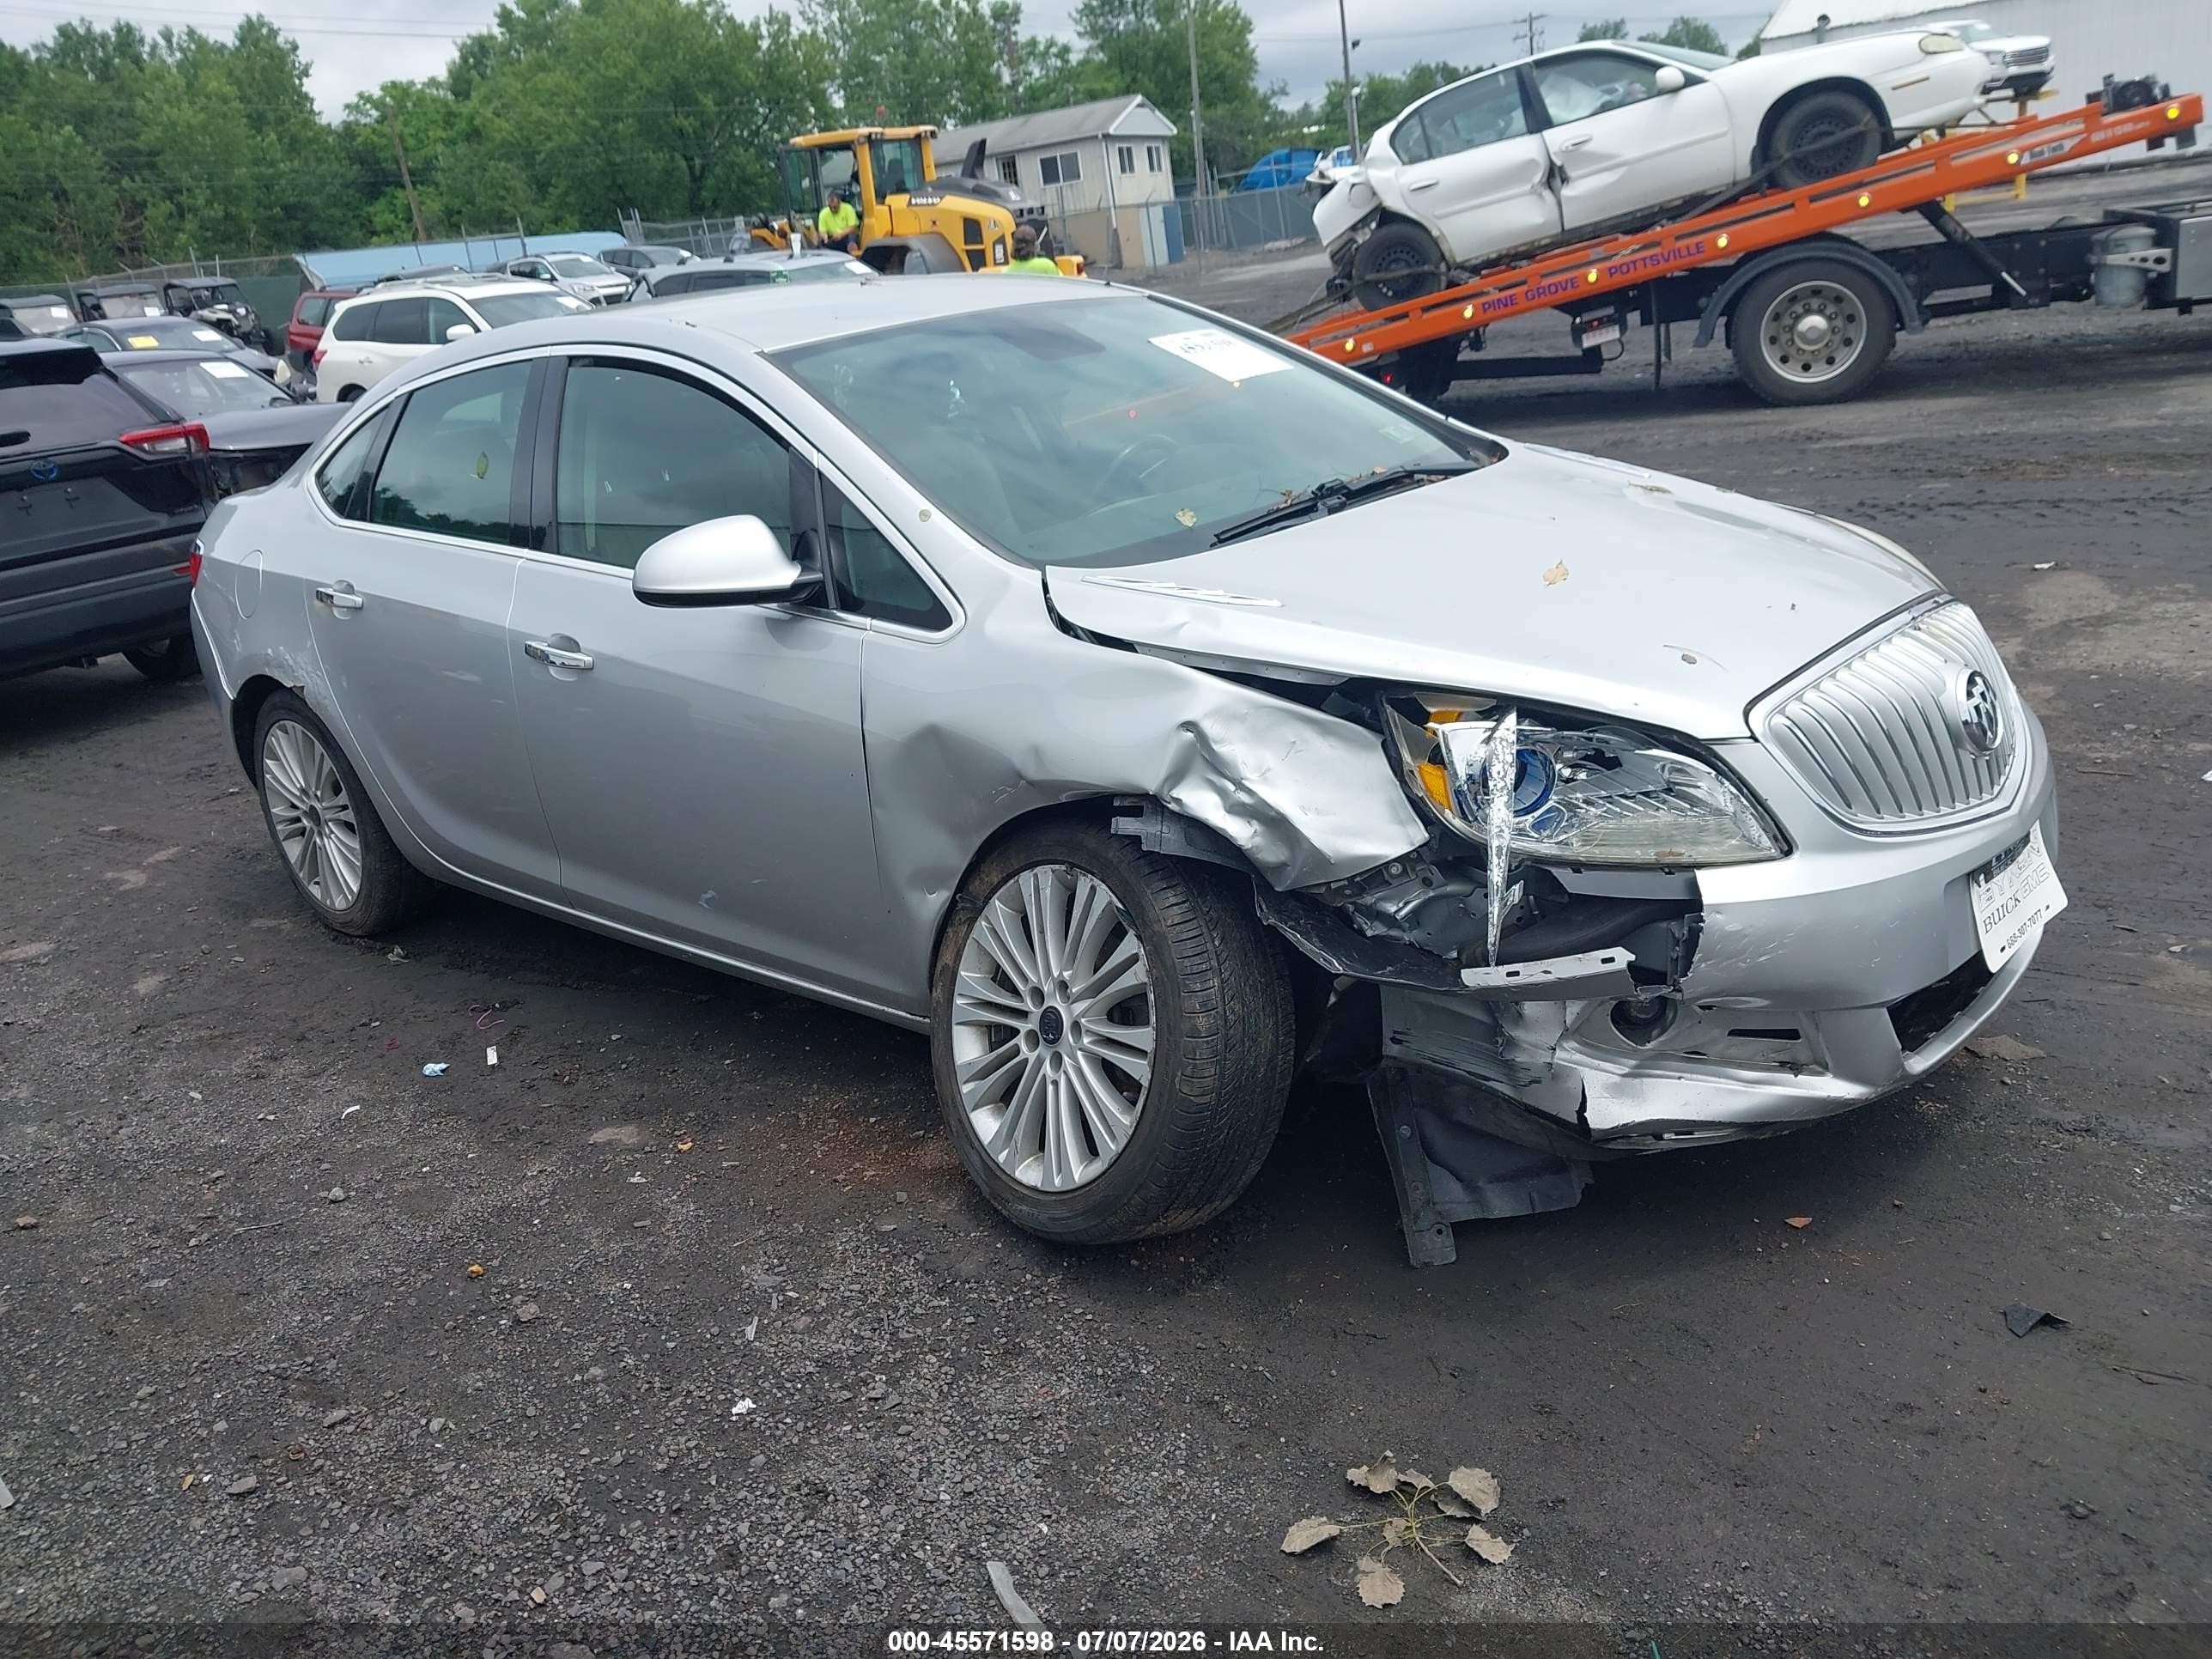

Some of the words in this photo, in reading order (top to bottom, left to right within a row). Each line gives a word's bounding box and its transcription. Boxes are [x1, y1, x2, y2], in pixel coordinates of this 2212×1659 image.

[1481, 295, 1518, 314] PINE
[1525, 276, 1580, 302] GROVE
[1607, 241, 1705, 278] POTTSVILLE
[1983, 890, 2021, 934] BUICK
